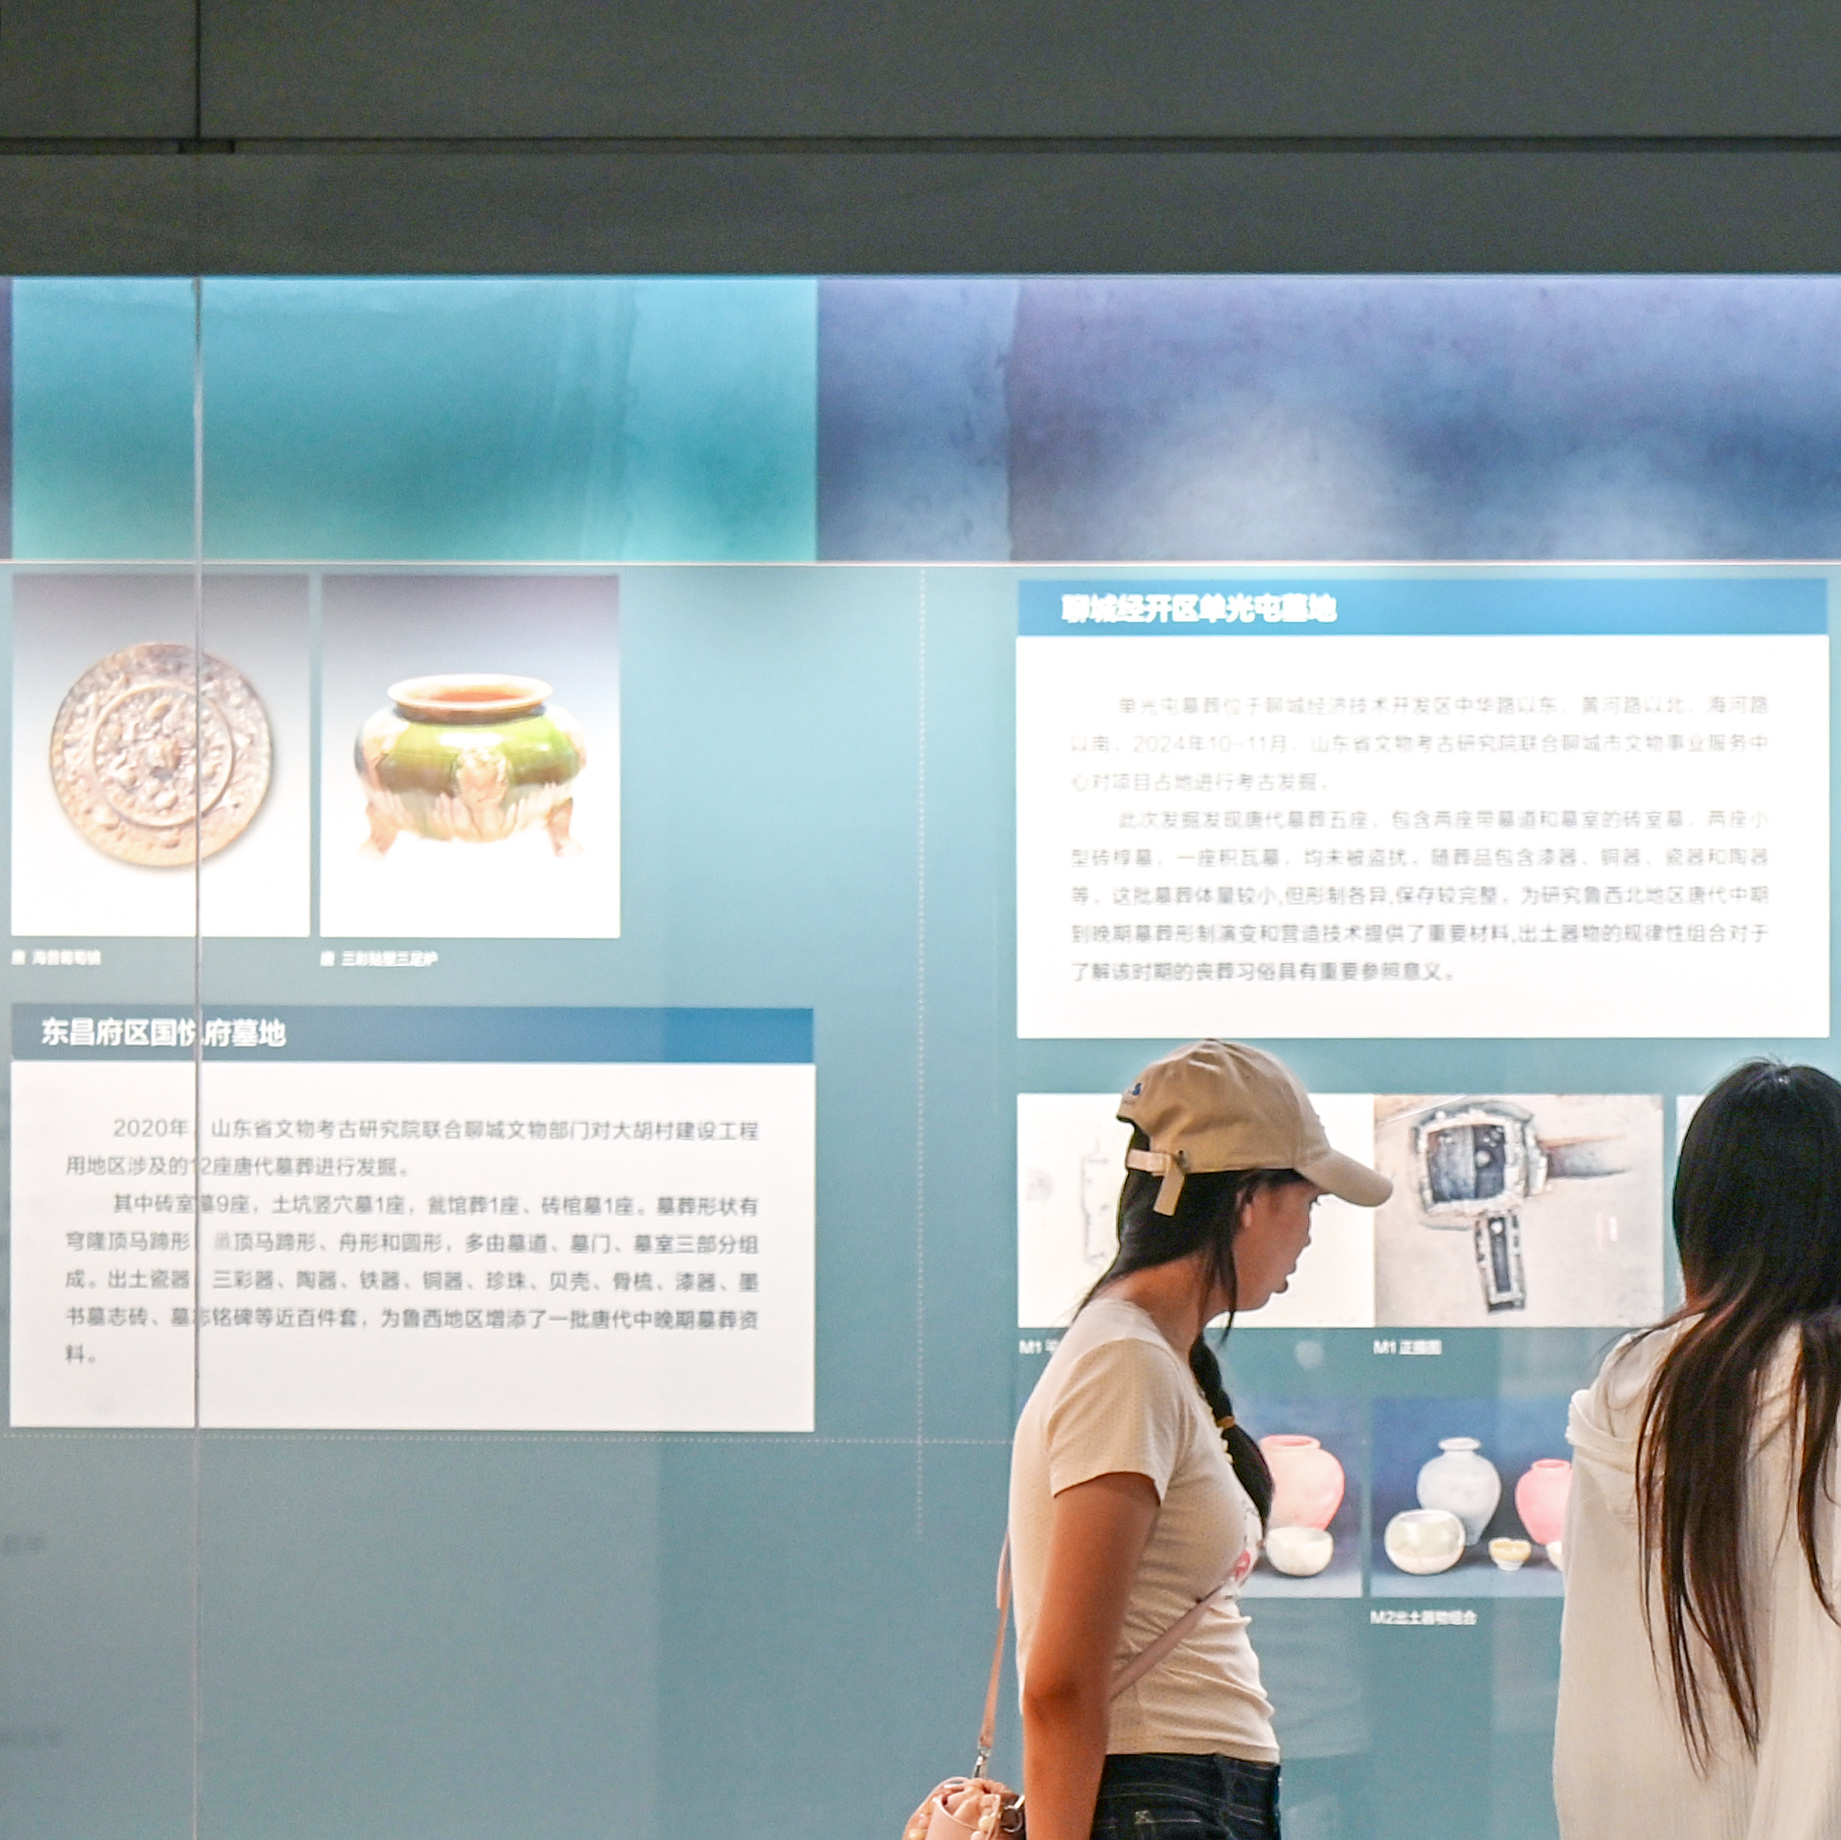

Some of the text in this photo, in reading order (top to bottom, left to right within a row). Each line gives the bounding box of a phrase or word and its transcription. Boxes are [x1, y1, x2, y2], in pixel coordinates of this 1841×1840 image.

[1060, 593, 1338, 623] 聊城经开区单光屯墓地
[113, 1117, 759, 1141] 2020年山东省文物考古研究院联合聊城文物部门对大胡村建设工程
[65, 1268, 759, 1293] 成。出土瓷器三彩器、陶器、铁器、铜器、珍珠、贝壳、骨梳、漆器、墨
[65, 1344, 95, 1363] 料。
